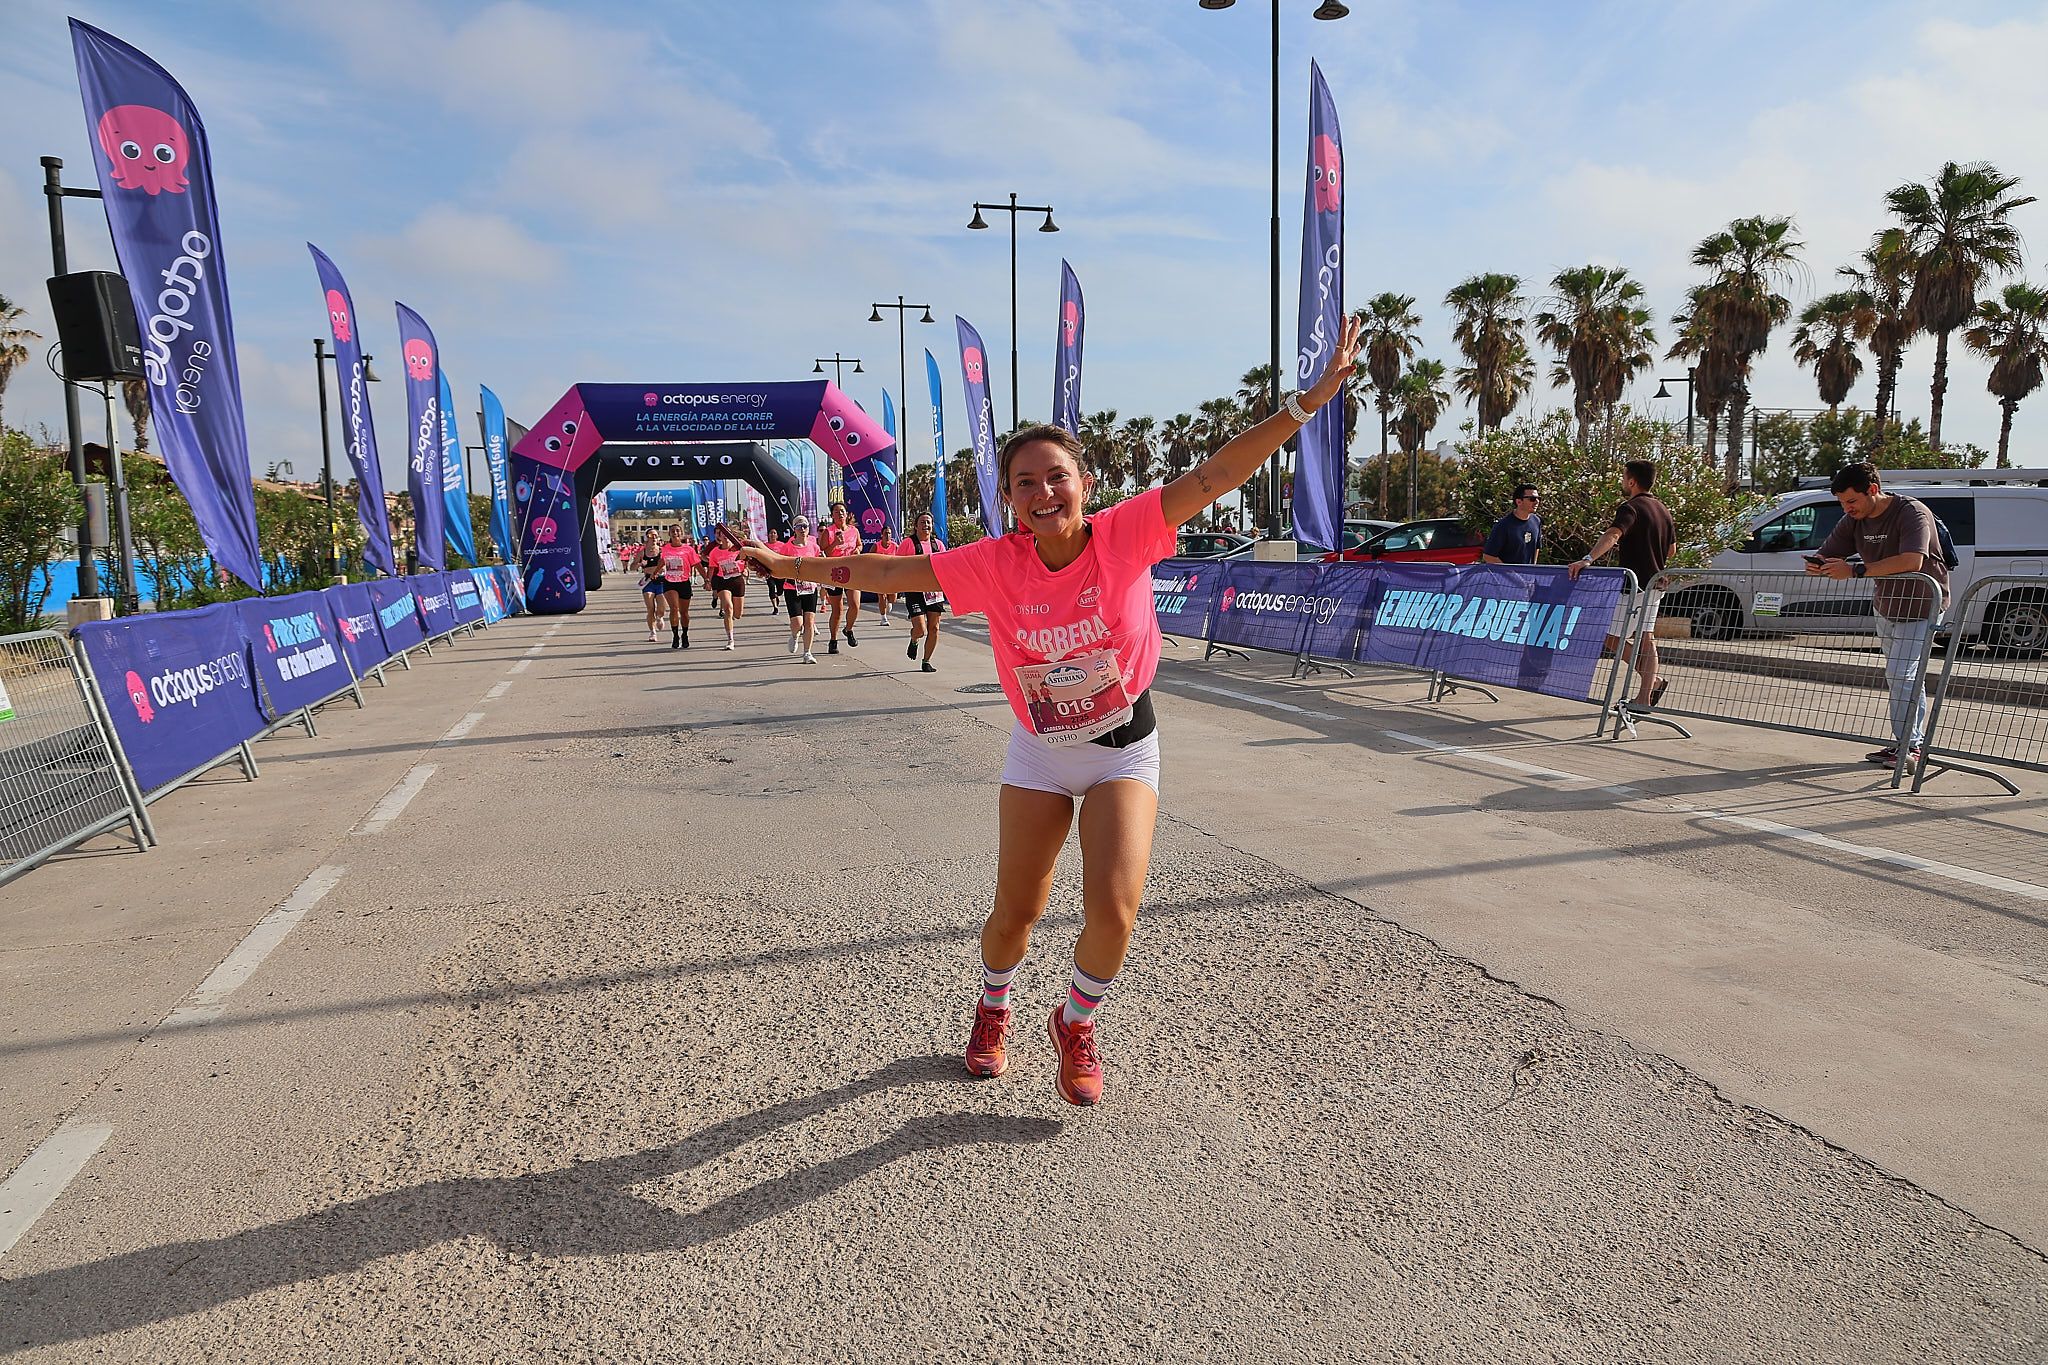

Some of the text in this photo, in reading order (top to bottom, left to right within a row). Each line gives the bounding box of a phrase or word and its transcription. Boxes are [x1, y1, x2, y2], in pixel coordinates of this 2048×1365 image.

[662, 393, 768, 408] octopus energy
[636, 411, 773, 421] LA ENERGÍA PARA CORRER
[723, 423, 737, 431] DE
[740, 423, 753, 431] LA
[619, 455, 733, 467] VOLVO
[635, 491, 673, 508] Marlene
[1015, 603, 1050, 615] OYSHO
[1156, 594, 1171, 612] LA
[1166, 595, 1188, 614] LUZ
[1236, 590, 1342, 625] octopus energy
[1374, 589, 1582, 651] ¡ENHORABUENA!
[1016, 614, 1112, 653] CARRERA
[151, 663, 214, 708] octopus
[1047, 674, 1085, 685] ASTURIANA
[1056, 697, 1095, 716] 016
[1043, 725, 1065, 733] CARRERA
[1098, 706, 1121, 720] VALENCIA
[1095, 715, 1124, 732] Santander
[1047, 733, 1078, 744] OYSHO
